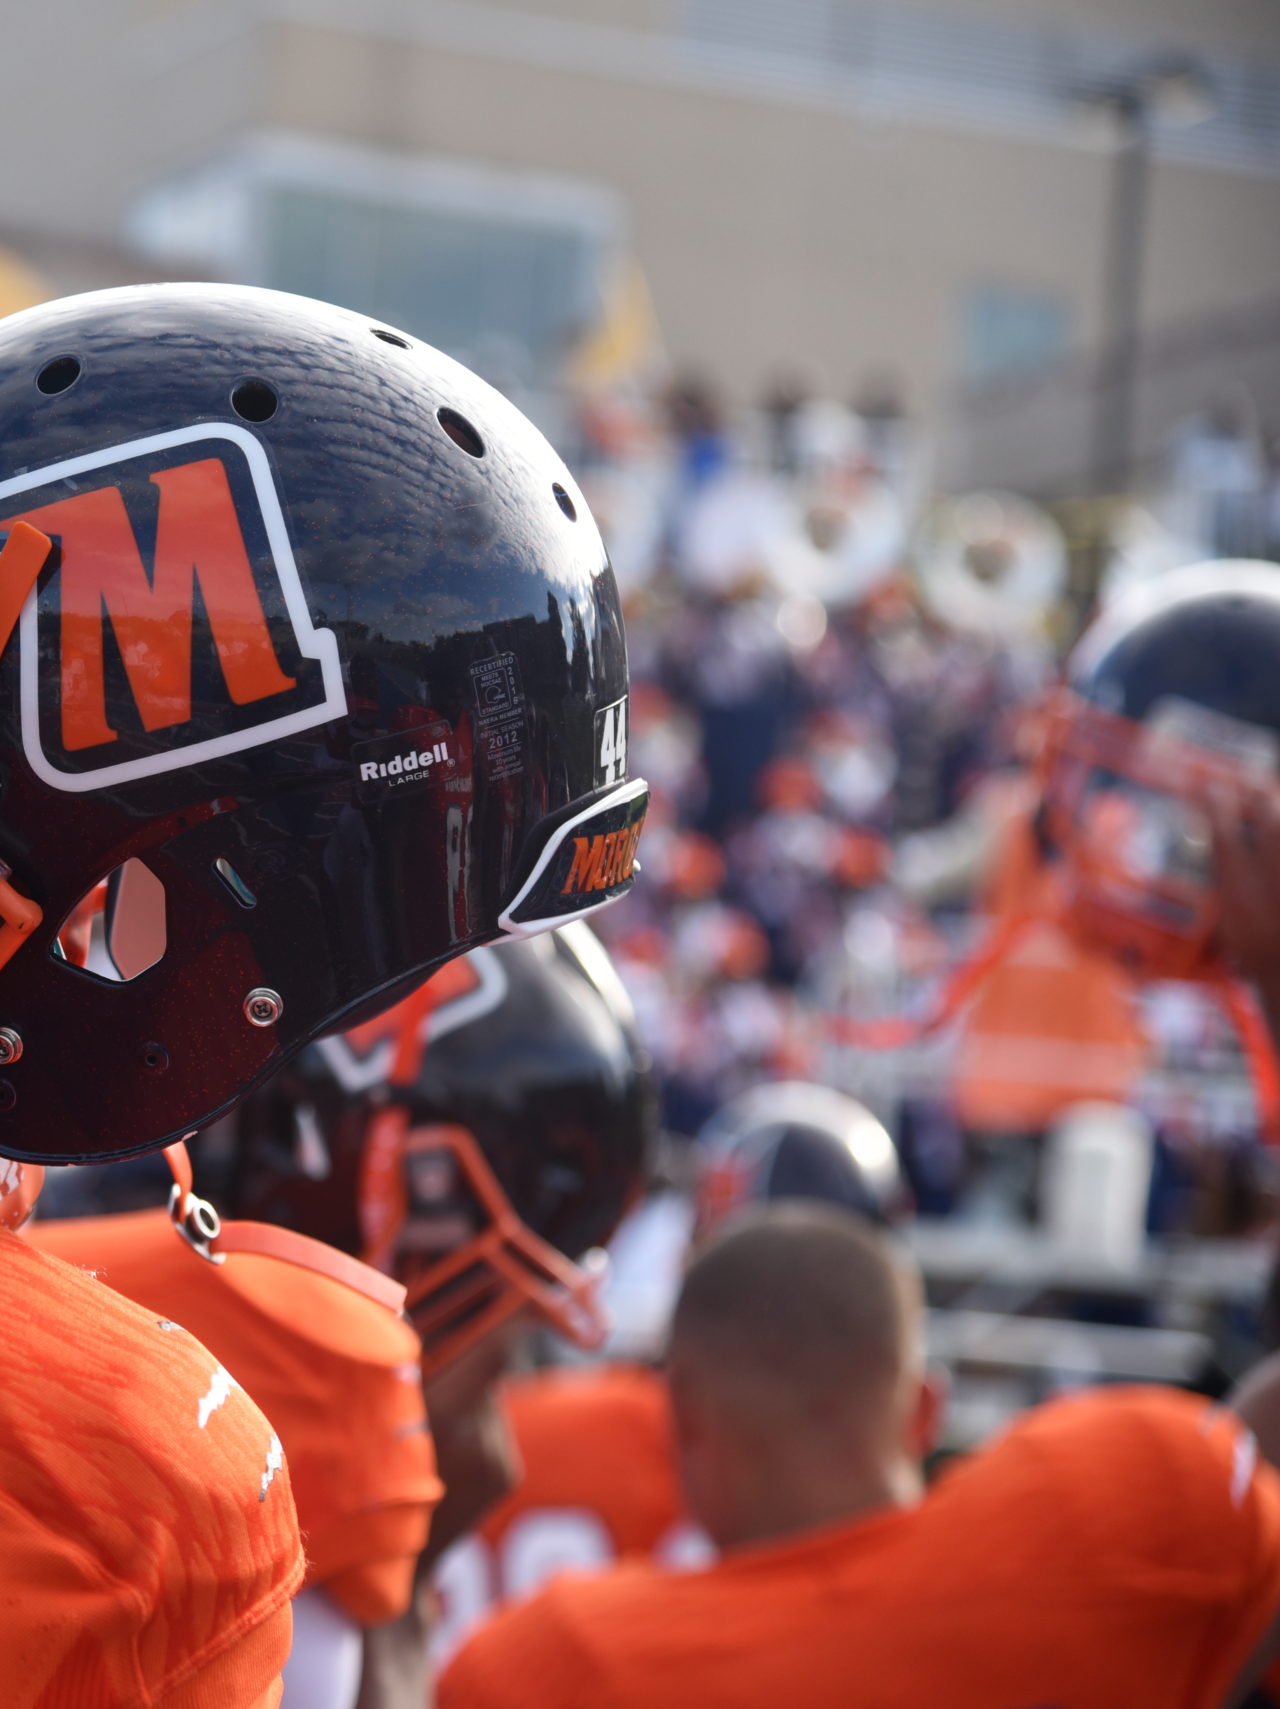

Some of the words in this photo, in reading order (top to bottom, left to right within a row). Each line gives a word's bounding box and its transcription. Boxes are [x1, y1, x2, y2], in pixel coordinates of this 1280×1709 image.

[470, 656, 514, 676] RECERTIFIED
[481, 671, 499, 681] MEETS
[482, 702, 510, 715] STANDARD
[488, 730, 518, 750] 2012
[600, 700, 627, 784] 44
[360, 741, 449, 782] Riddell
[388, 769, 430, 787] LARGE
